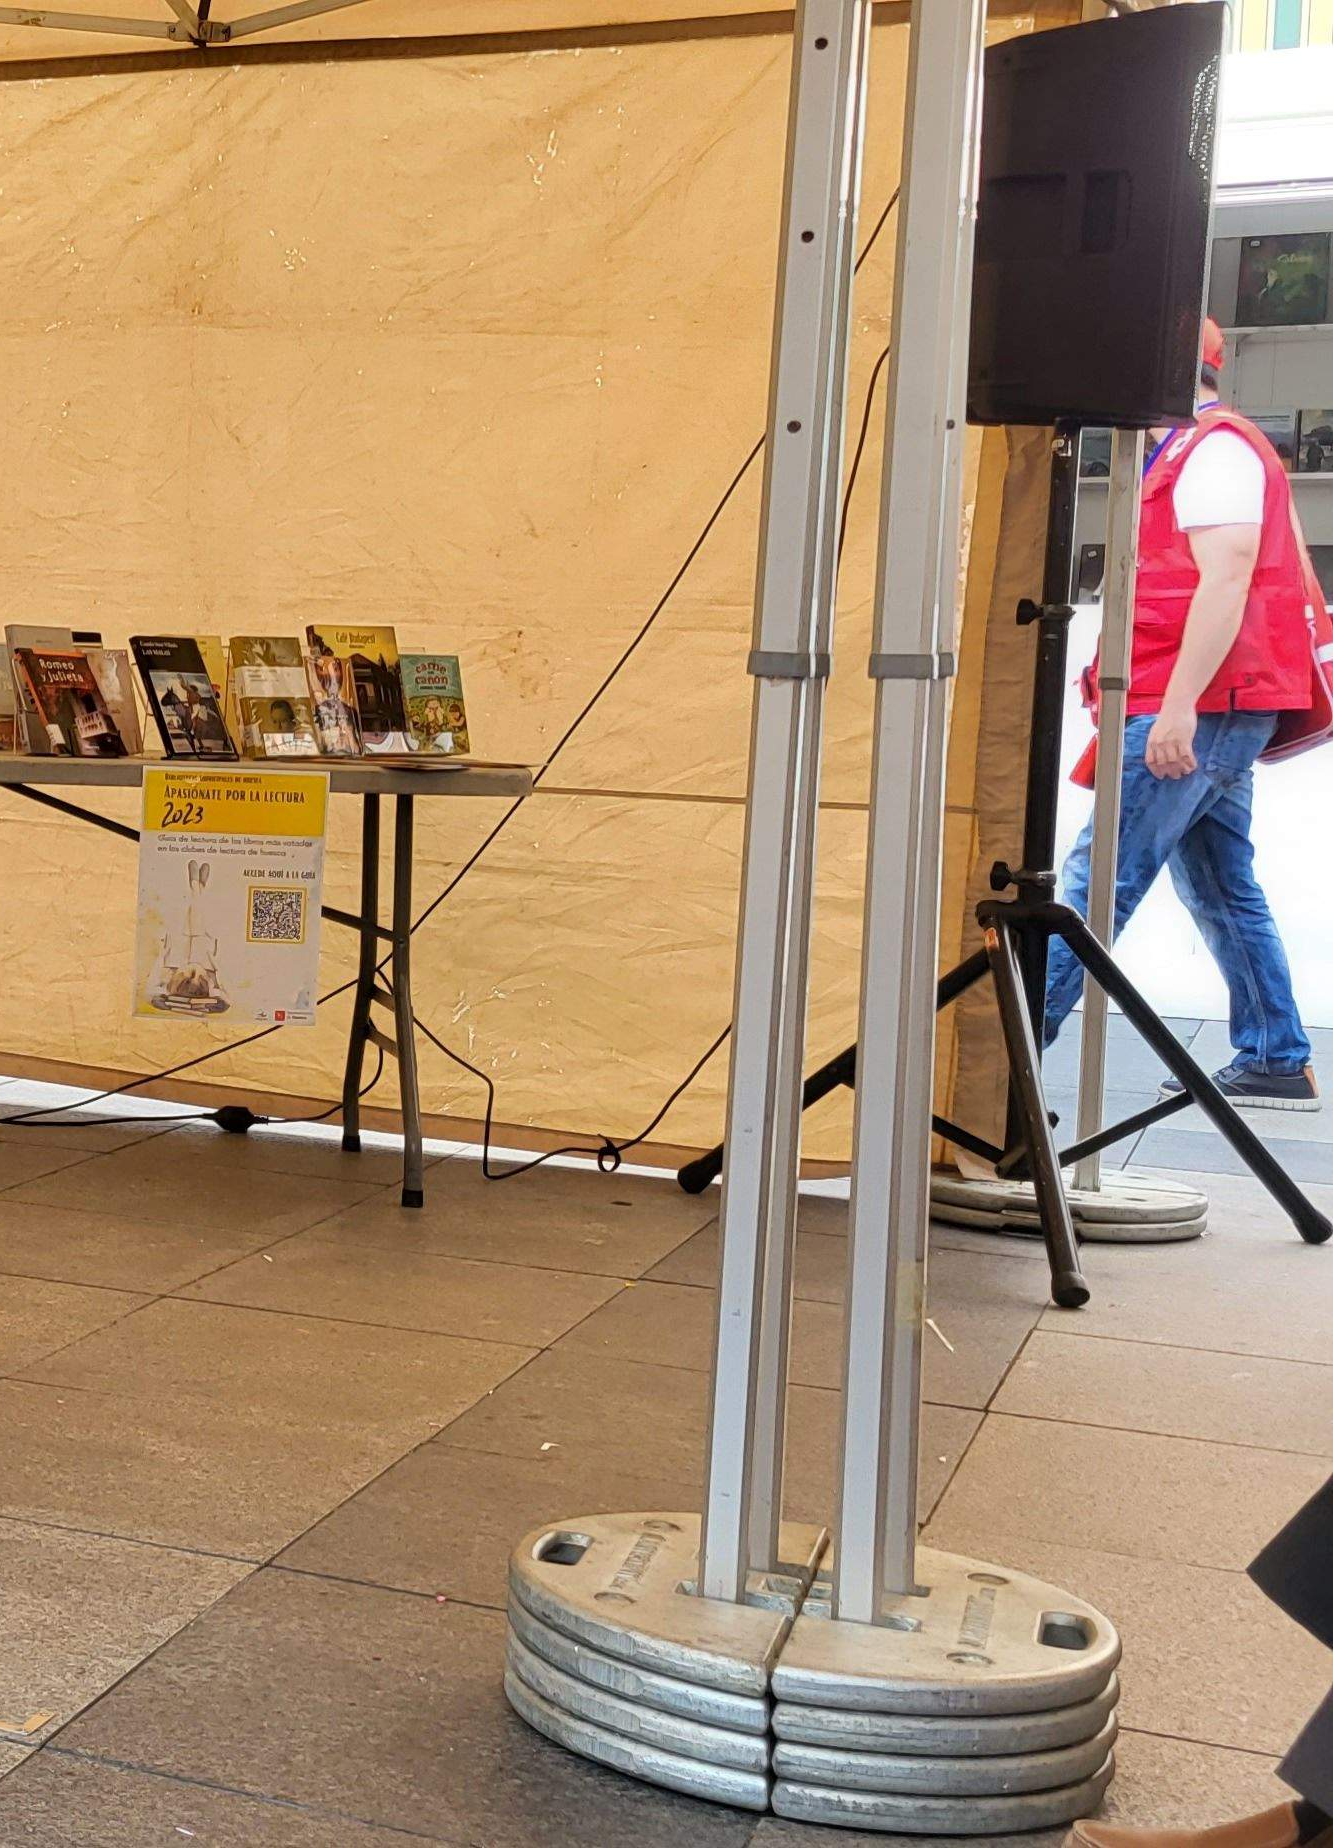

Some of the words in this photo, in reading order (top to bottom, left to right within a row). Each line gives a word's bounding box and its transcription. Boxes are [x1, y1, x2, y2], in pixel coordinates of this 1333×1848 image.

[38, 658, 75, 670] Romeo
[40, 673, 46, 682] y
[47, 670, 84, 683] Julieta
[164, 784, 222, 800] APASIÓNATE
[226, 789, 246, 801] POR
[249, 790, 261, 802] LA
[264, 791, 305, 803] LECTURA
[161, 801, 204, 828] 2023
